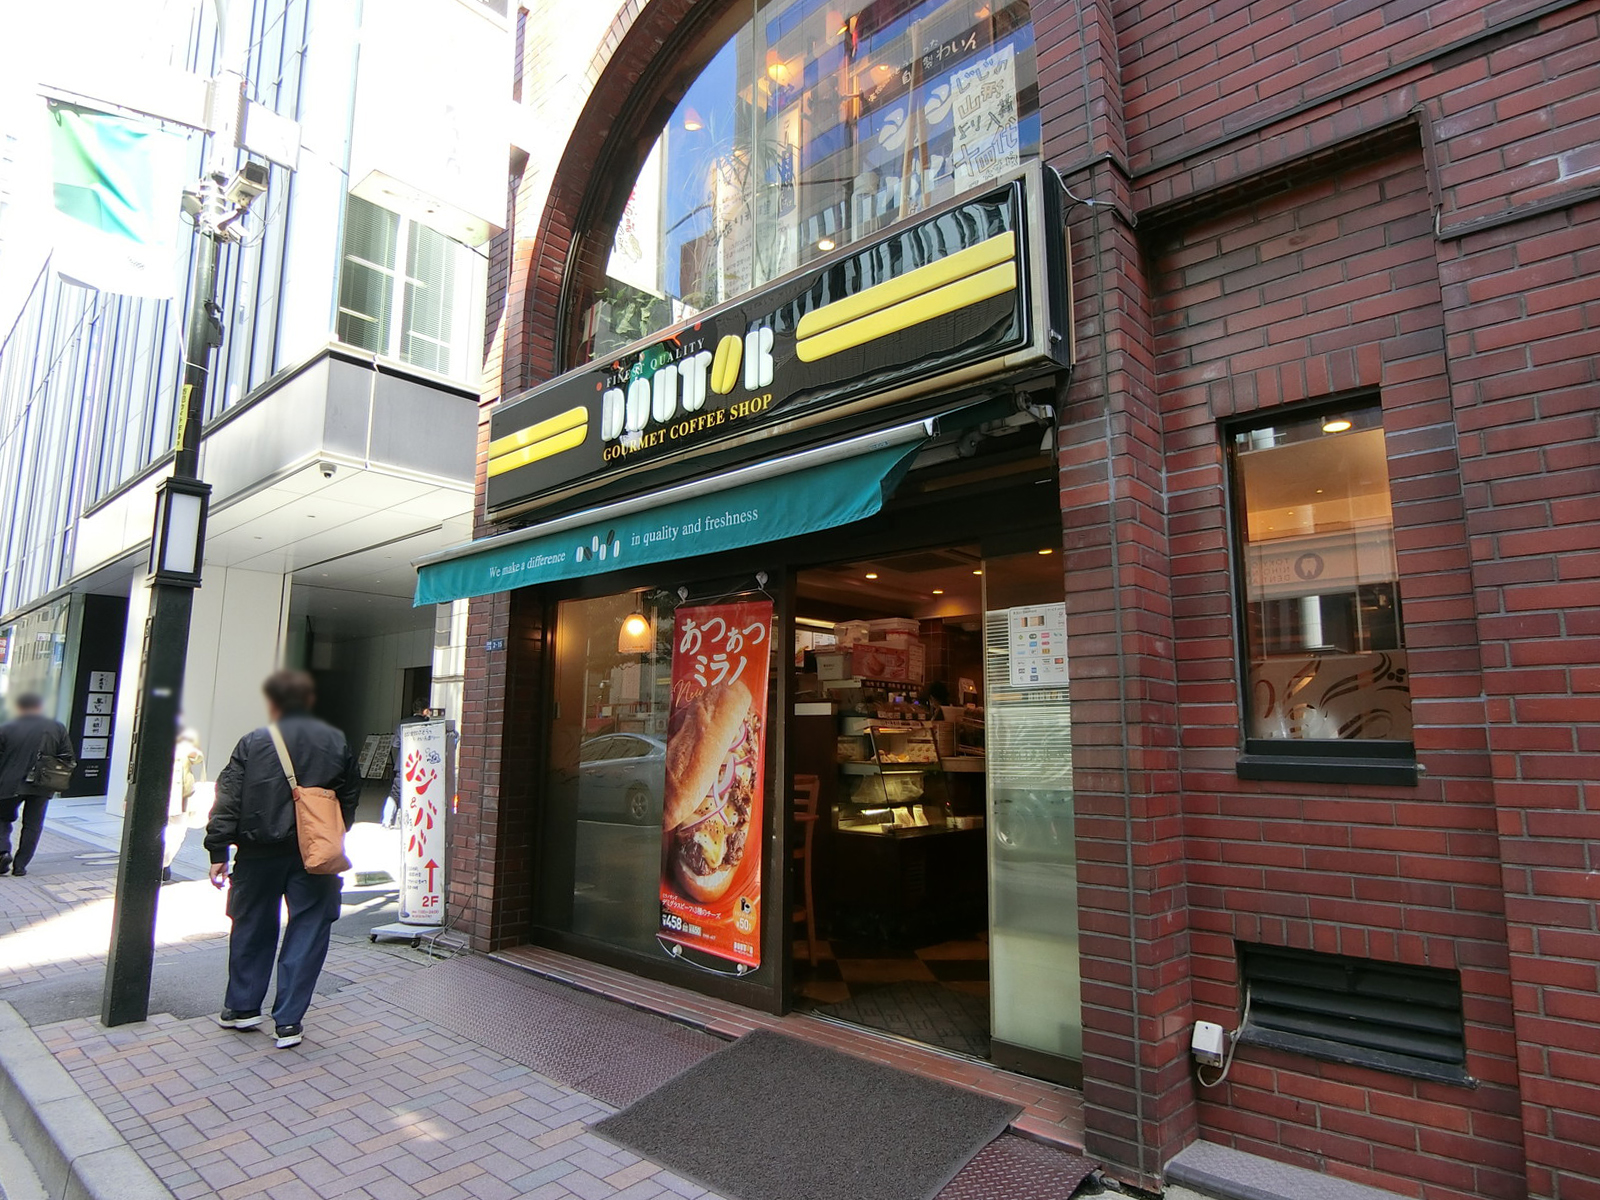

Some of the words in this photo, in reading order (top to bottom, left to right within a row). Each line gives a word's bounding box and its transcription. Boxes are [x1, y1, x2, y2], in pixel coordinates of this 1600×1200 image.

[958, 79, 1004, 119] 山形
[606, 363, 645, 388] FINEST
[650, 338, 705, 370] QUALITY
[601, 327, 774, 442] DOUTOR
[603, 429, 666, 461] GOURMET
[669, 409, 725, 439] COFFEE
[729, 393, 773, 420] SHOP
[489, 566, 501, 578] We
[502, 562, 520, 576] make
[527, 552, 566, 570] difference
[631, 532, 641, 546] in
[643, 525, 679, 546] quality
[682, 518, 702, 535] and
[704, 508, 759, 531] freshness
[680, 617, 766, 655] あつあつ
[693, 653, 748, 687] ミラノ
[673, 679, 704, 708] New
[422, 895, 440, 908] 2F
